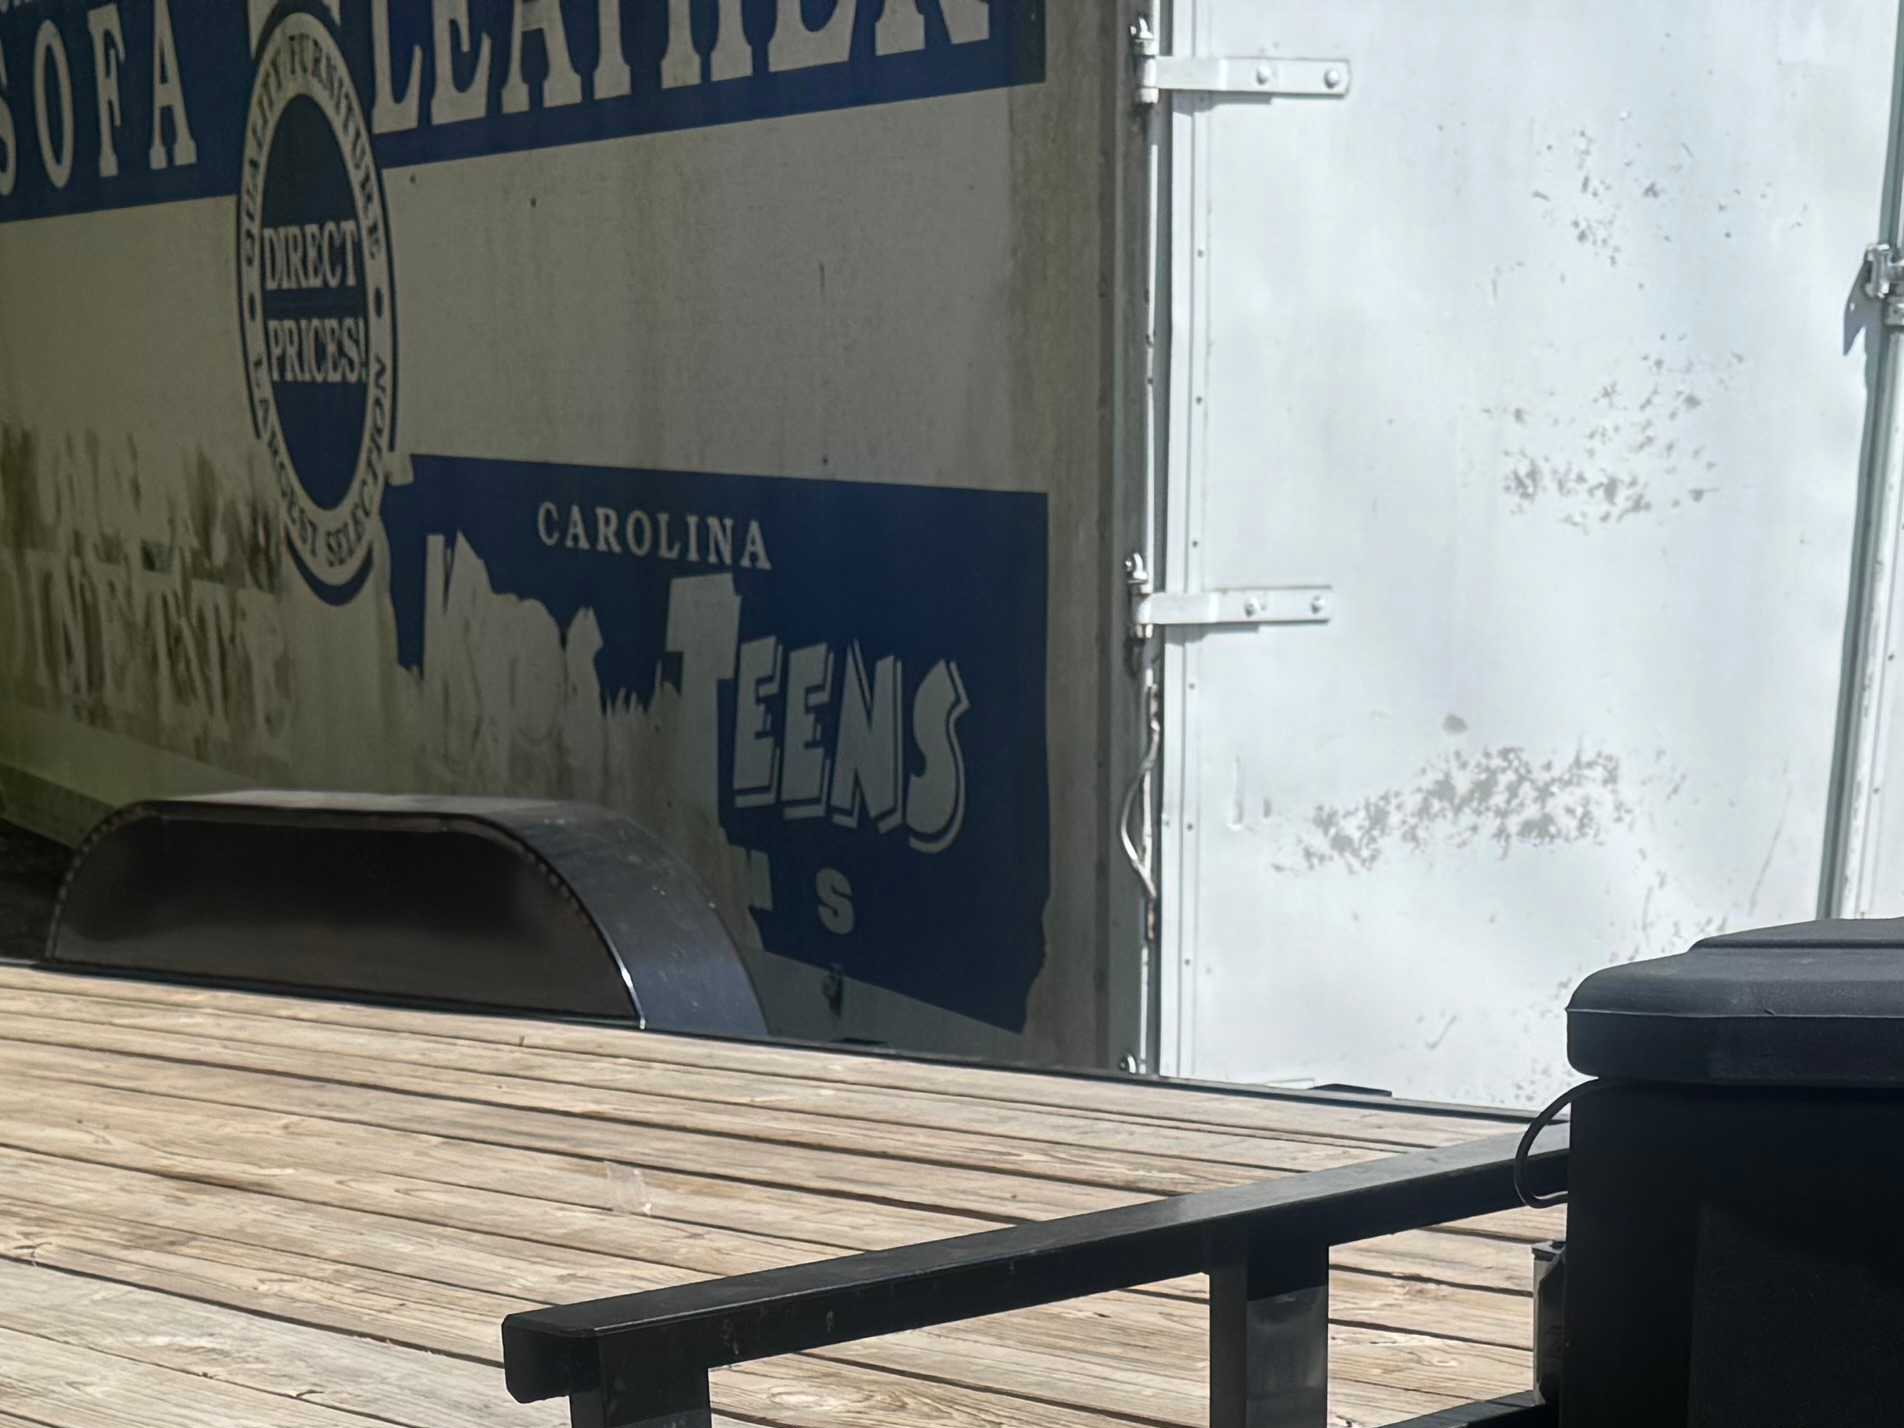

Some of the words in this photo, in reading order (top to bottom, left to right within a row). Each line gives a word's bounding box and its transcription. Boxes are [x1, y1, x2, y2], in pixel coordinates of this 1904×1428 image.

[262, 220, 358, 291] DIRECT
[266, 318, 369, 383] PRICES!
[537, 501, 773, 571] CAROLINA
